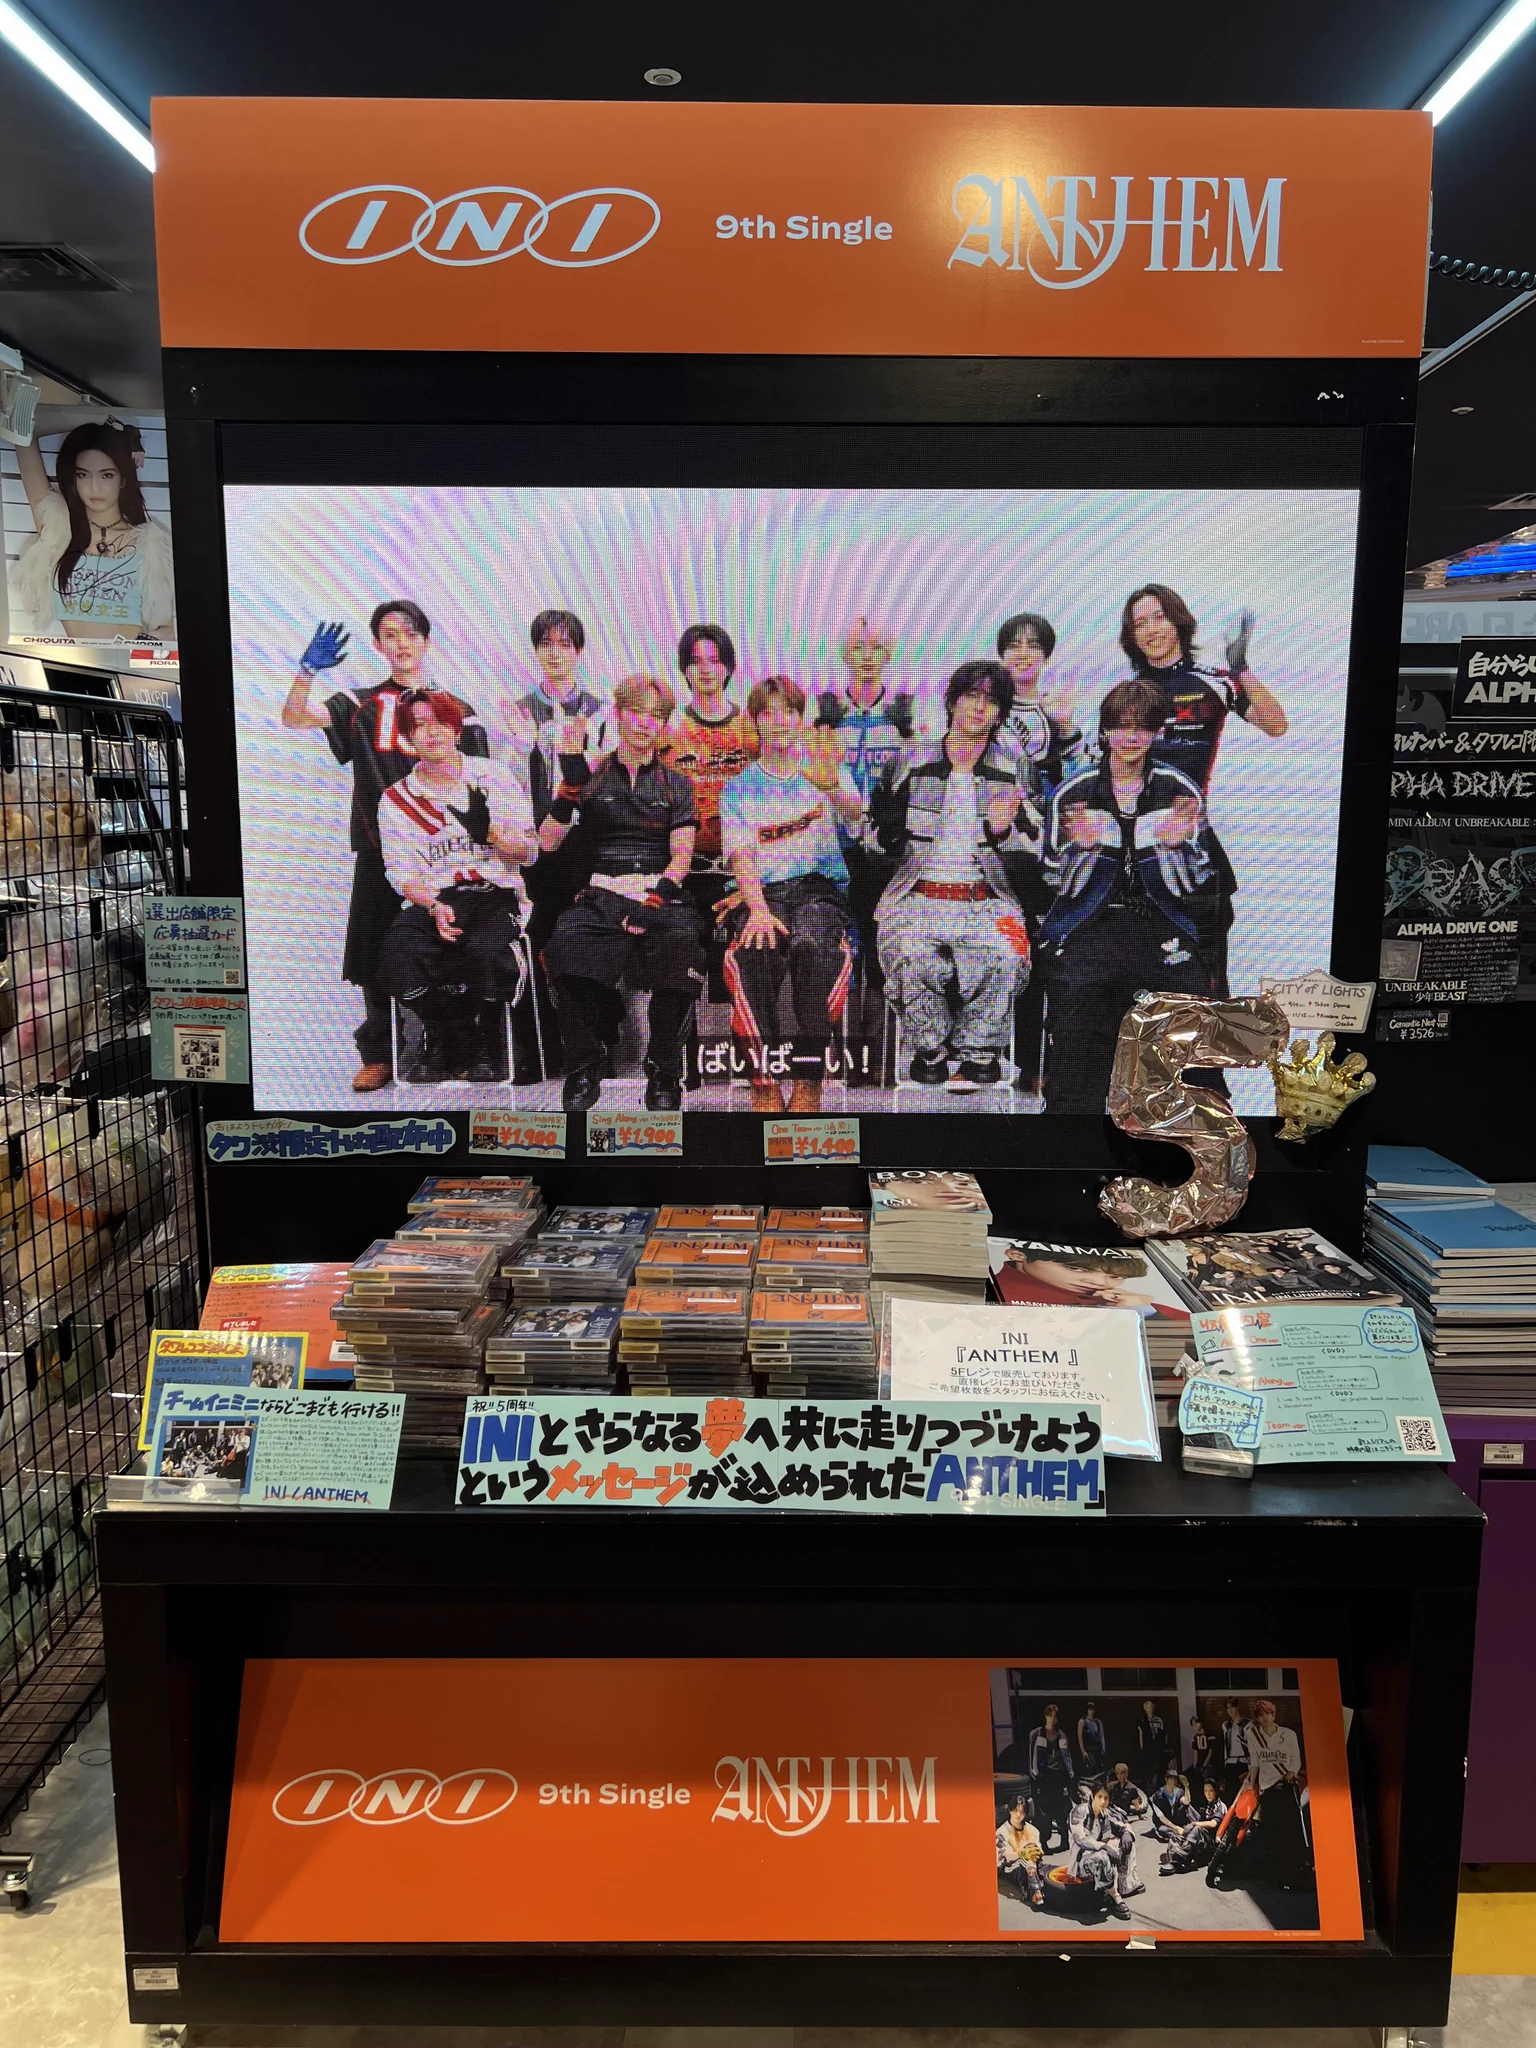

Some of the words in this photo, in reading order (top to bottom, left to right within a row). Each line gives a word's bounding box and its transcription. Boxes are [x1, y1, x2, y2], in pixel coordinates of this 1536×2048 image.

[715, 213, 776, 241] 9th
[784, 213, 894, 246] Single
[946, 173, 1287, 290] ANTHEM
[23, 636, 76, 645] CHIQUITA
[1388, 817, 1412, 827] MINI
[1414, 817, 1451, 828] ALBUM
[1454, 817, 1530, 828] UNBREAKABLE
[1396, 923, 1443, 937] ALPHA
[1446, 921, 1487, 935] DRIVE
[1488, 920, 1519, 933] ONE
[1273, 983, 1303, 995] CITY
[1304, 983, 1318, 994] of
[1321, 984, 1366, 998] LIGHTS
[1385, 980, 1468, 992] UNBREAKABLE
[473, 1112, 486, 1123] All
[502, 1113, 519, 1124] One
[592, 1114, 612, 1125] Sing
[615, 1113, 637, 1124] Along
[772, 1124, 789, 1135] One
[792, 1123, 812, 1133] Team
[876, 1170, 970, 1181] BOYS
[1011, 1300, 1048, 1308] MASAYA
[1001, 1332, 1029, 1346] INI
[950, 1367, 1086, 1381] 5Fレジで販売しております。
[958, 1377, 1081, 1389] 直接レジにお並びいただき
[1259, 1378, 1283, 1387] Along
[1266, 1421, 1290, 1430] Team
[264, 1485, 287, 1499] INI
[302, 1486, 369, 1503] ANTHEM
[1196, 1736, 1207, 1749] 10
[538, 1782, 590, 1806] 9th
[598, 1782, 692, 1810] Single
[711, 1755, 940, 1837] ANTHEM
